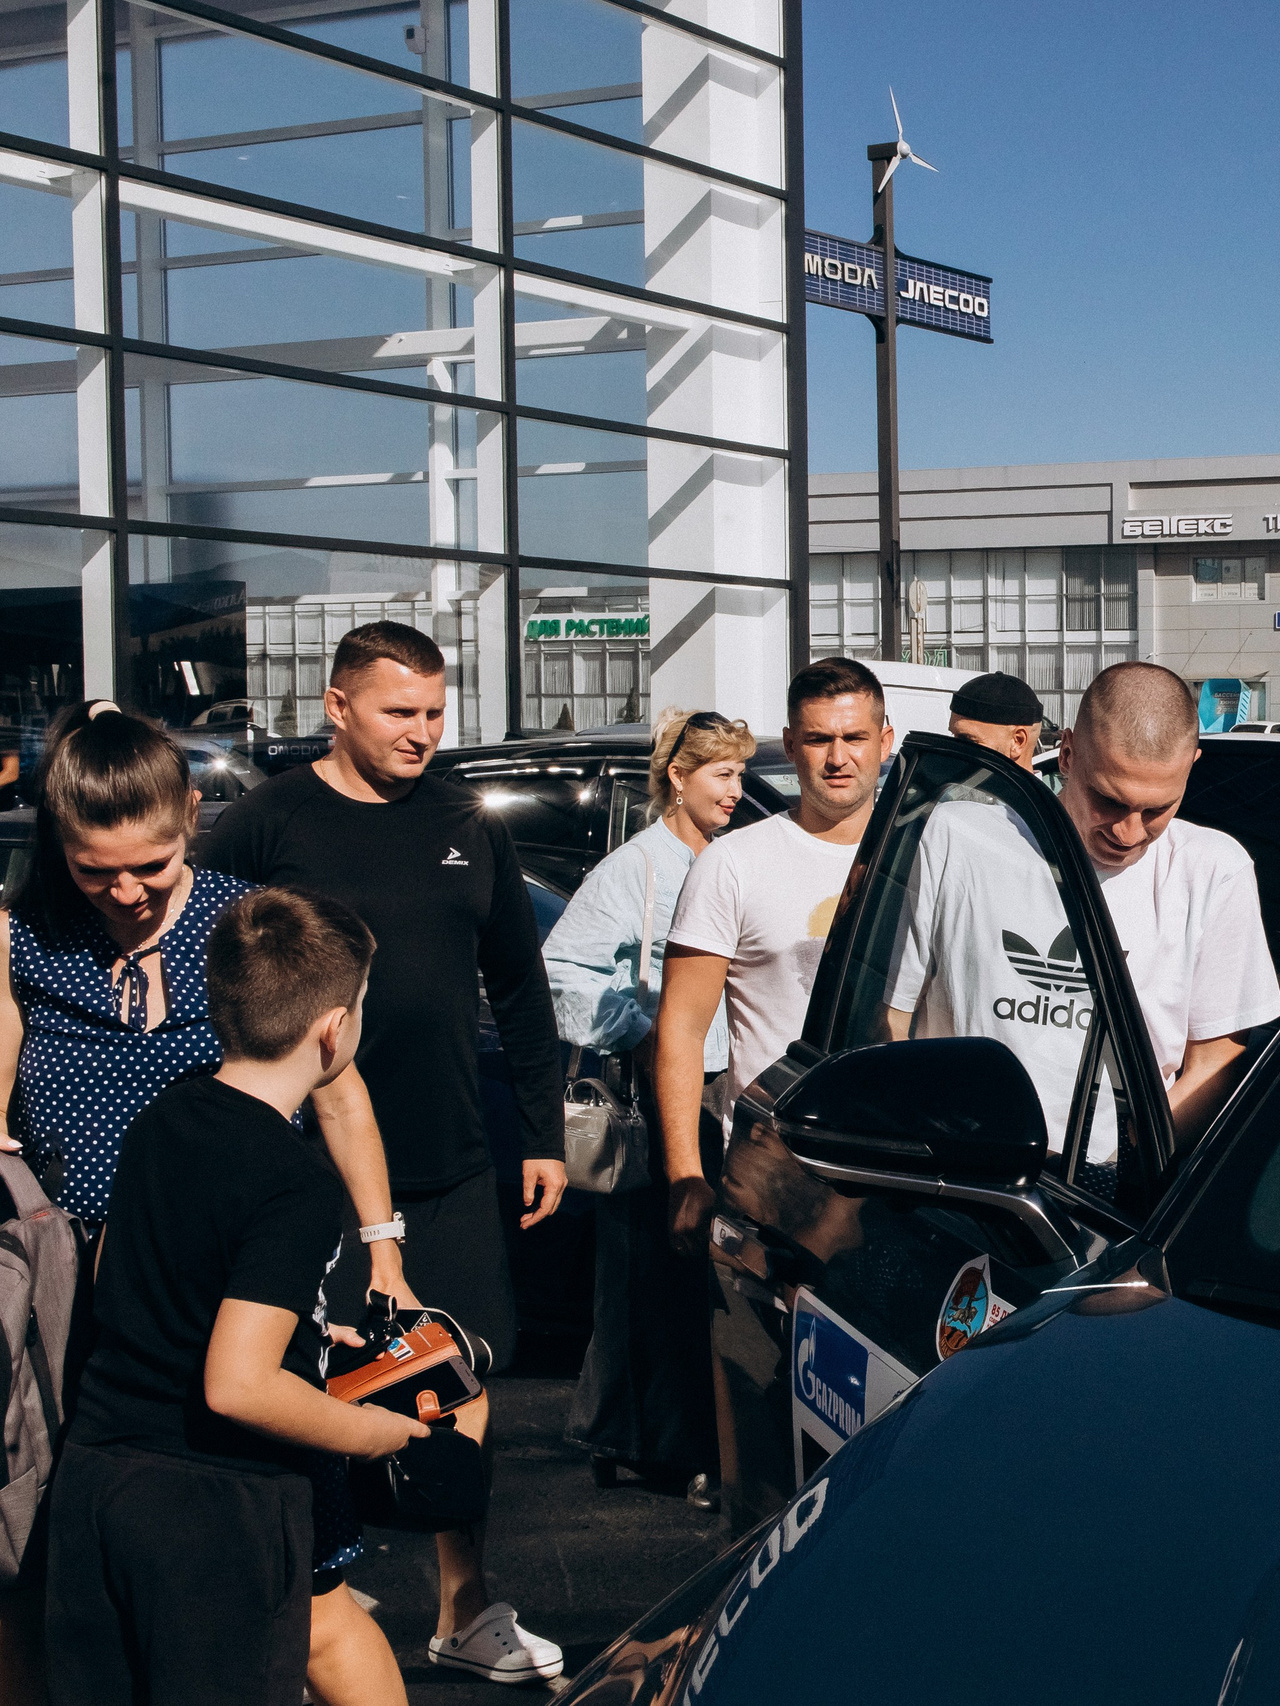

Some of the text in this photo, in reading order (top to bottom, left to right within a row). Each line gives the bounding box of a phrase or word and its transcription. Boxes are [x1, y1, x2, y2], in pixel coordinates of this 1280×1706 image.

[900, 279, 988, 317] JAECOO
[268, 745, 320, 756] OMODA
[991, 1303, 1001, 1320] 85
